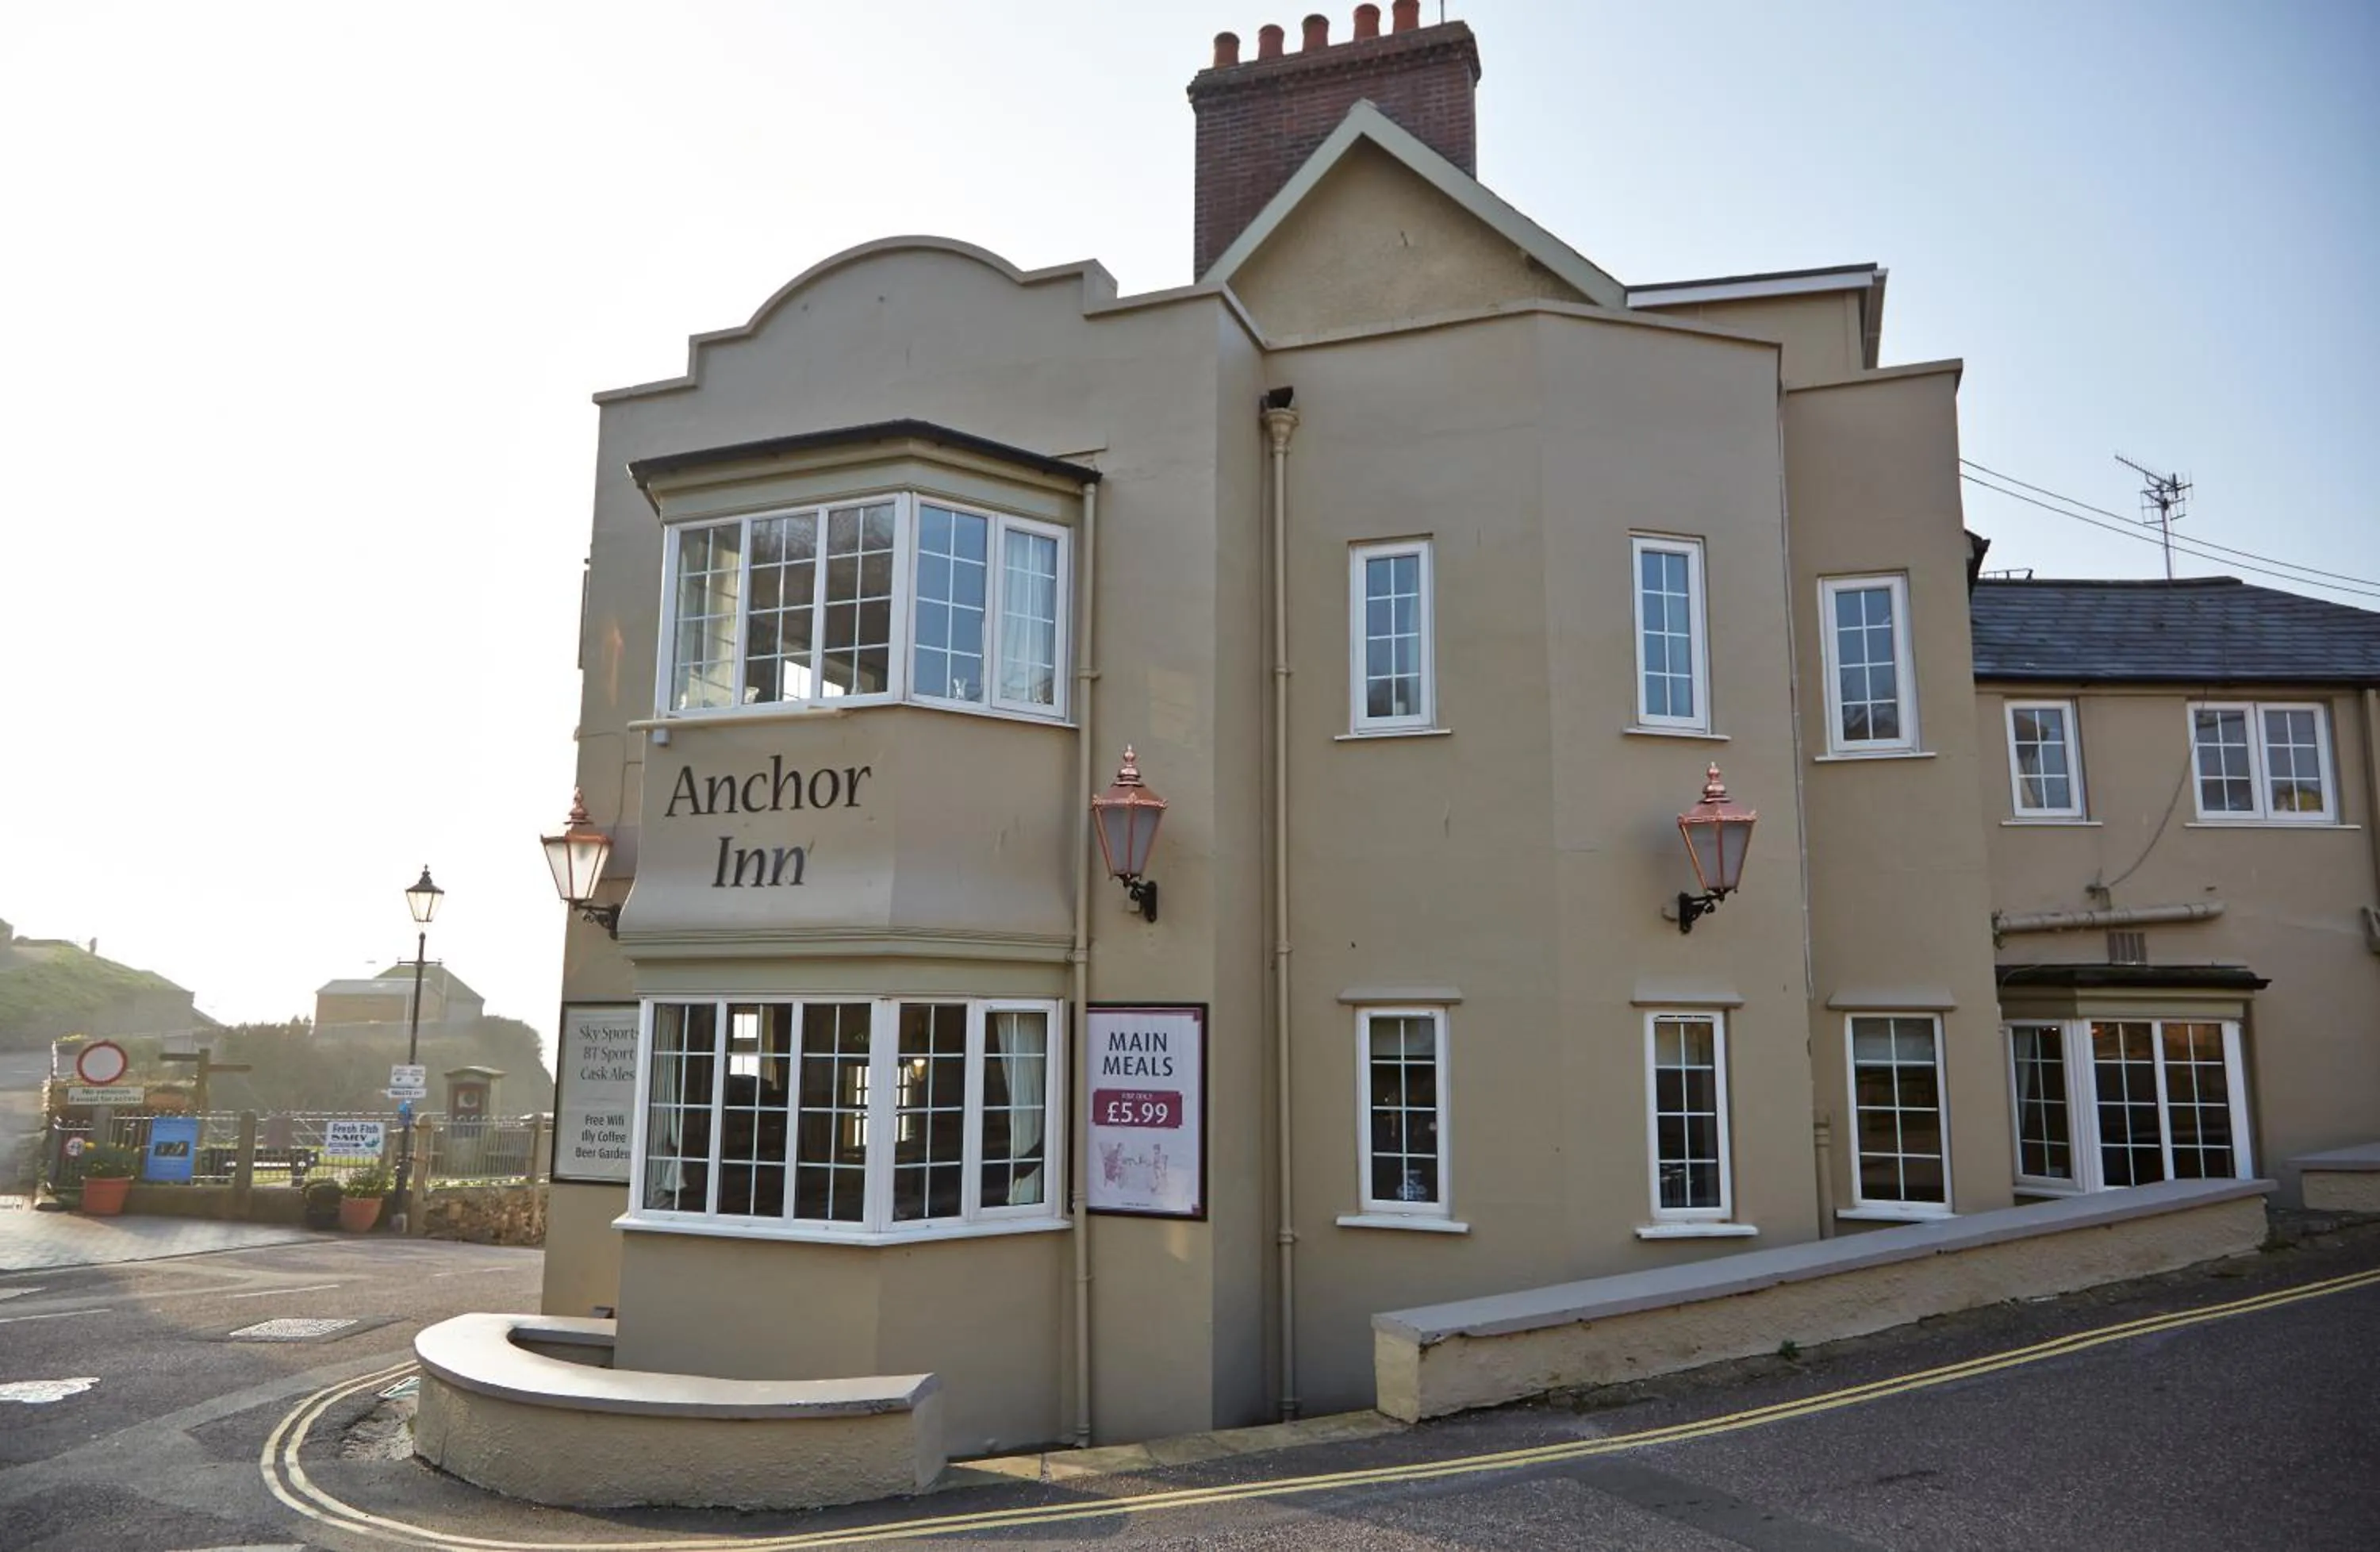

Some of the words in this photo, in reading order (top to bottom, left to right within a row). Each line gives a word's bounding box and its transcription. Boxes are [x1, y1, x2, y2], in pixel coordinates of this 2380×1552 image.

[664, 755, 872, 816] Anchor
[712, 836, 804, 888] Inn
[579, 1024, 600, 1043] Sky
[1108, 1031, 1168, 1052] MAIN
[584, 1045, 600, 1060] BT
[601, 1046, 635, 1063] Sport
[580, 1066, 608, 1081] Cask
[610, 1066, 635, 1081] Ales
[1103, 1056, 1173, 1077] MEALS
[585, 1114, 605, 1126] Free
[607, 1114, 625, 1127] Wifi
[1107, 1101, 1169, 1124] £5.99
[332, 1123, 357, 1134] Fresh
[597, 1130, 627, 1143] Coffee
[575, 1147, 597, 1158] Beer
